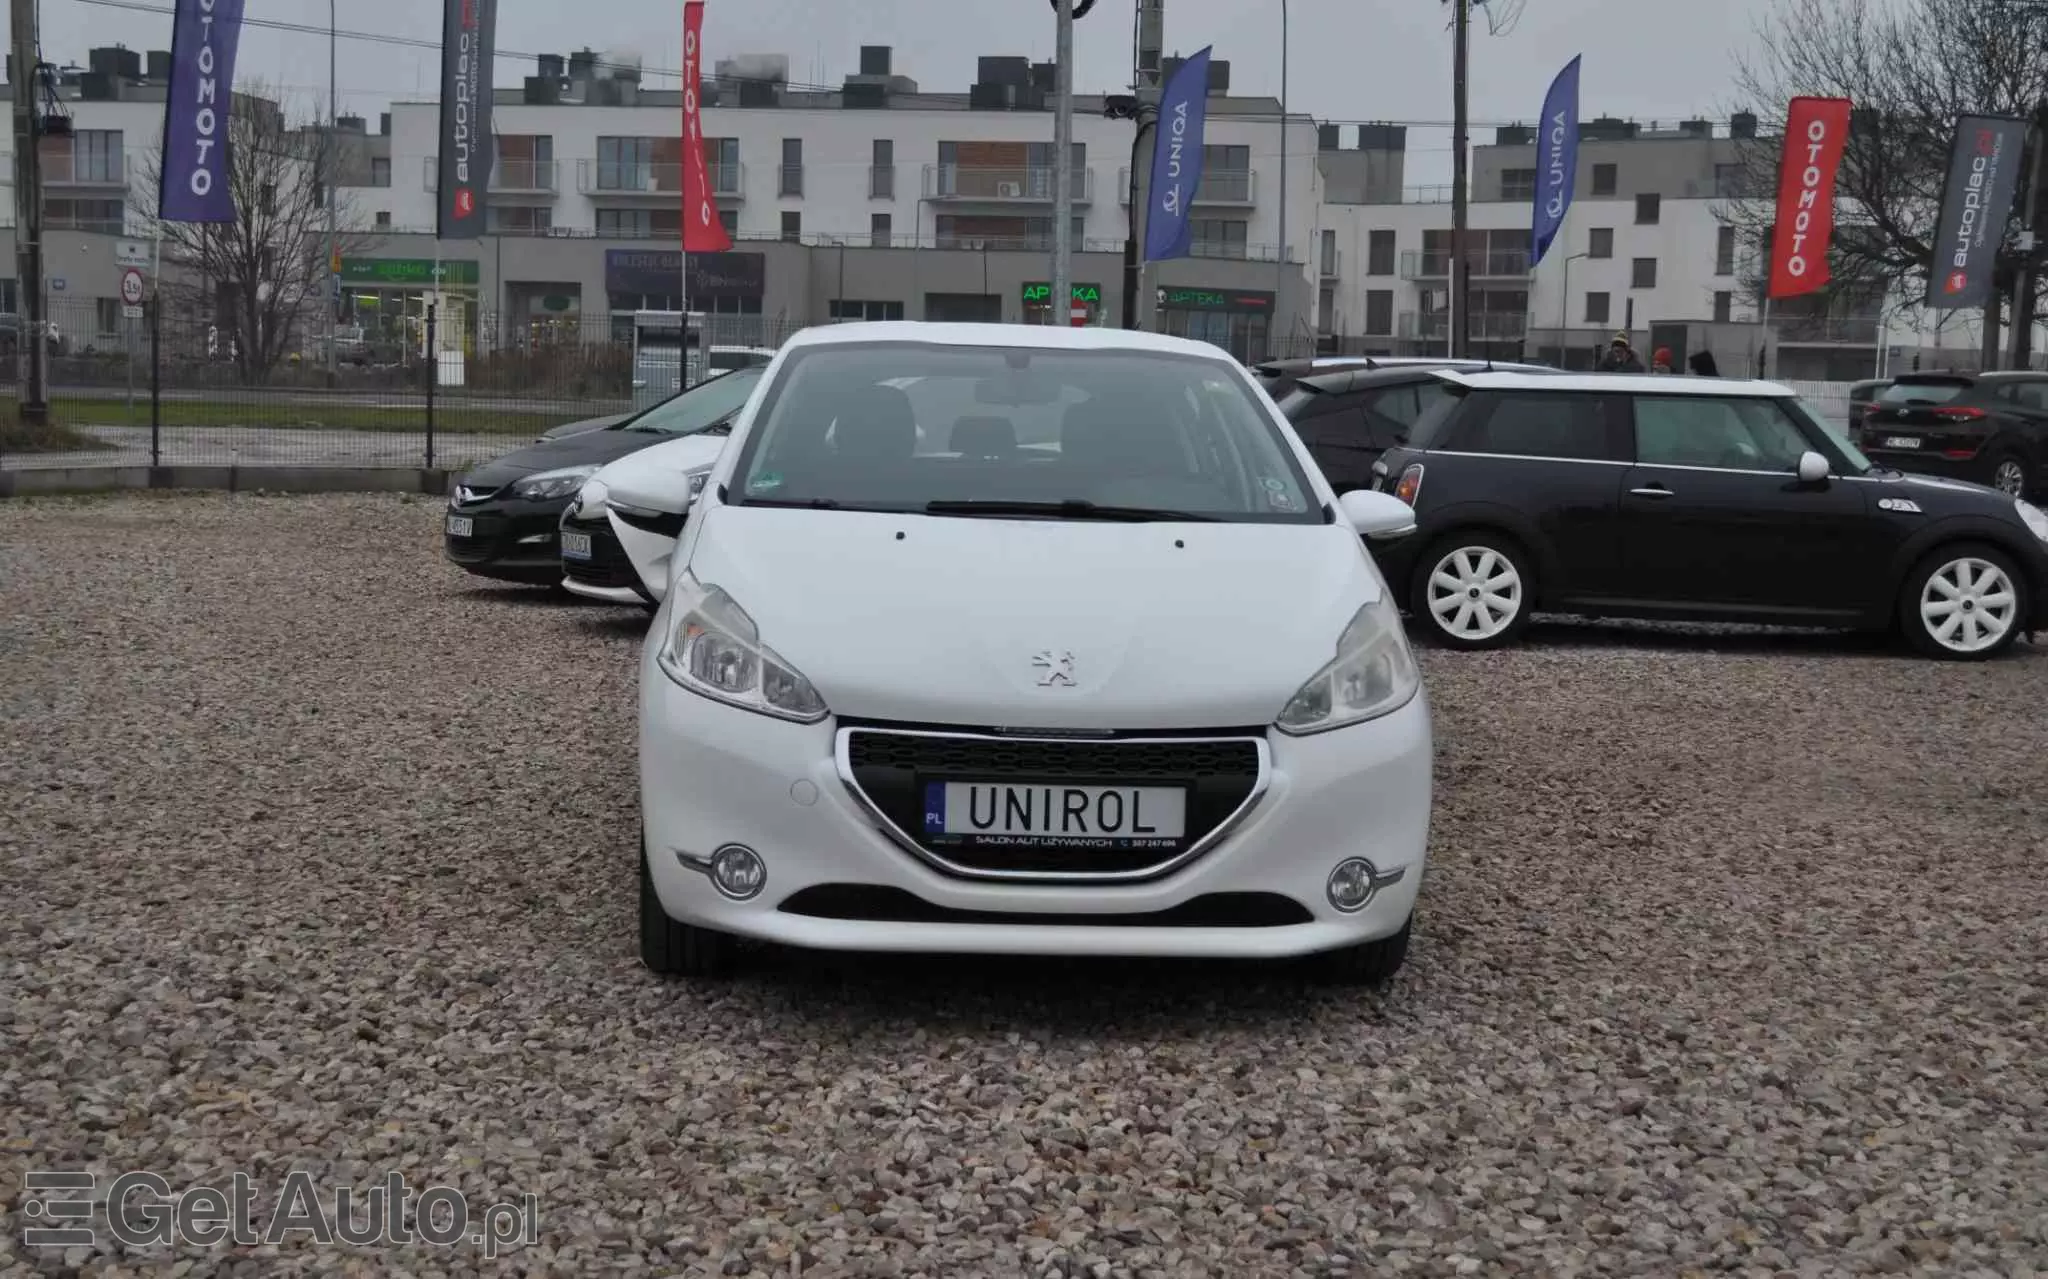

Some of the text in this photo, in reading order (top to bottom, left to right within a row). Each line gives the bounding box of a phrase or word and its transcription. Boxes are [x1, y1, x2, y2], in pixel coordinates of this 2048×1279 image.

[1167, 101, 1188, 178] UNIQA
[1550, 111, 1566, 185] UNIQA
[1788, 120, 1825, 277] OTOMOTO
[1023, 286, 1099, 301] APKA
[926, 812, 943, 825] PL
[969, 786, 1156, 832] UNIROL
[976, 835, 1014, 845] SALON
[1016, 837, 1040, 846] AUT
